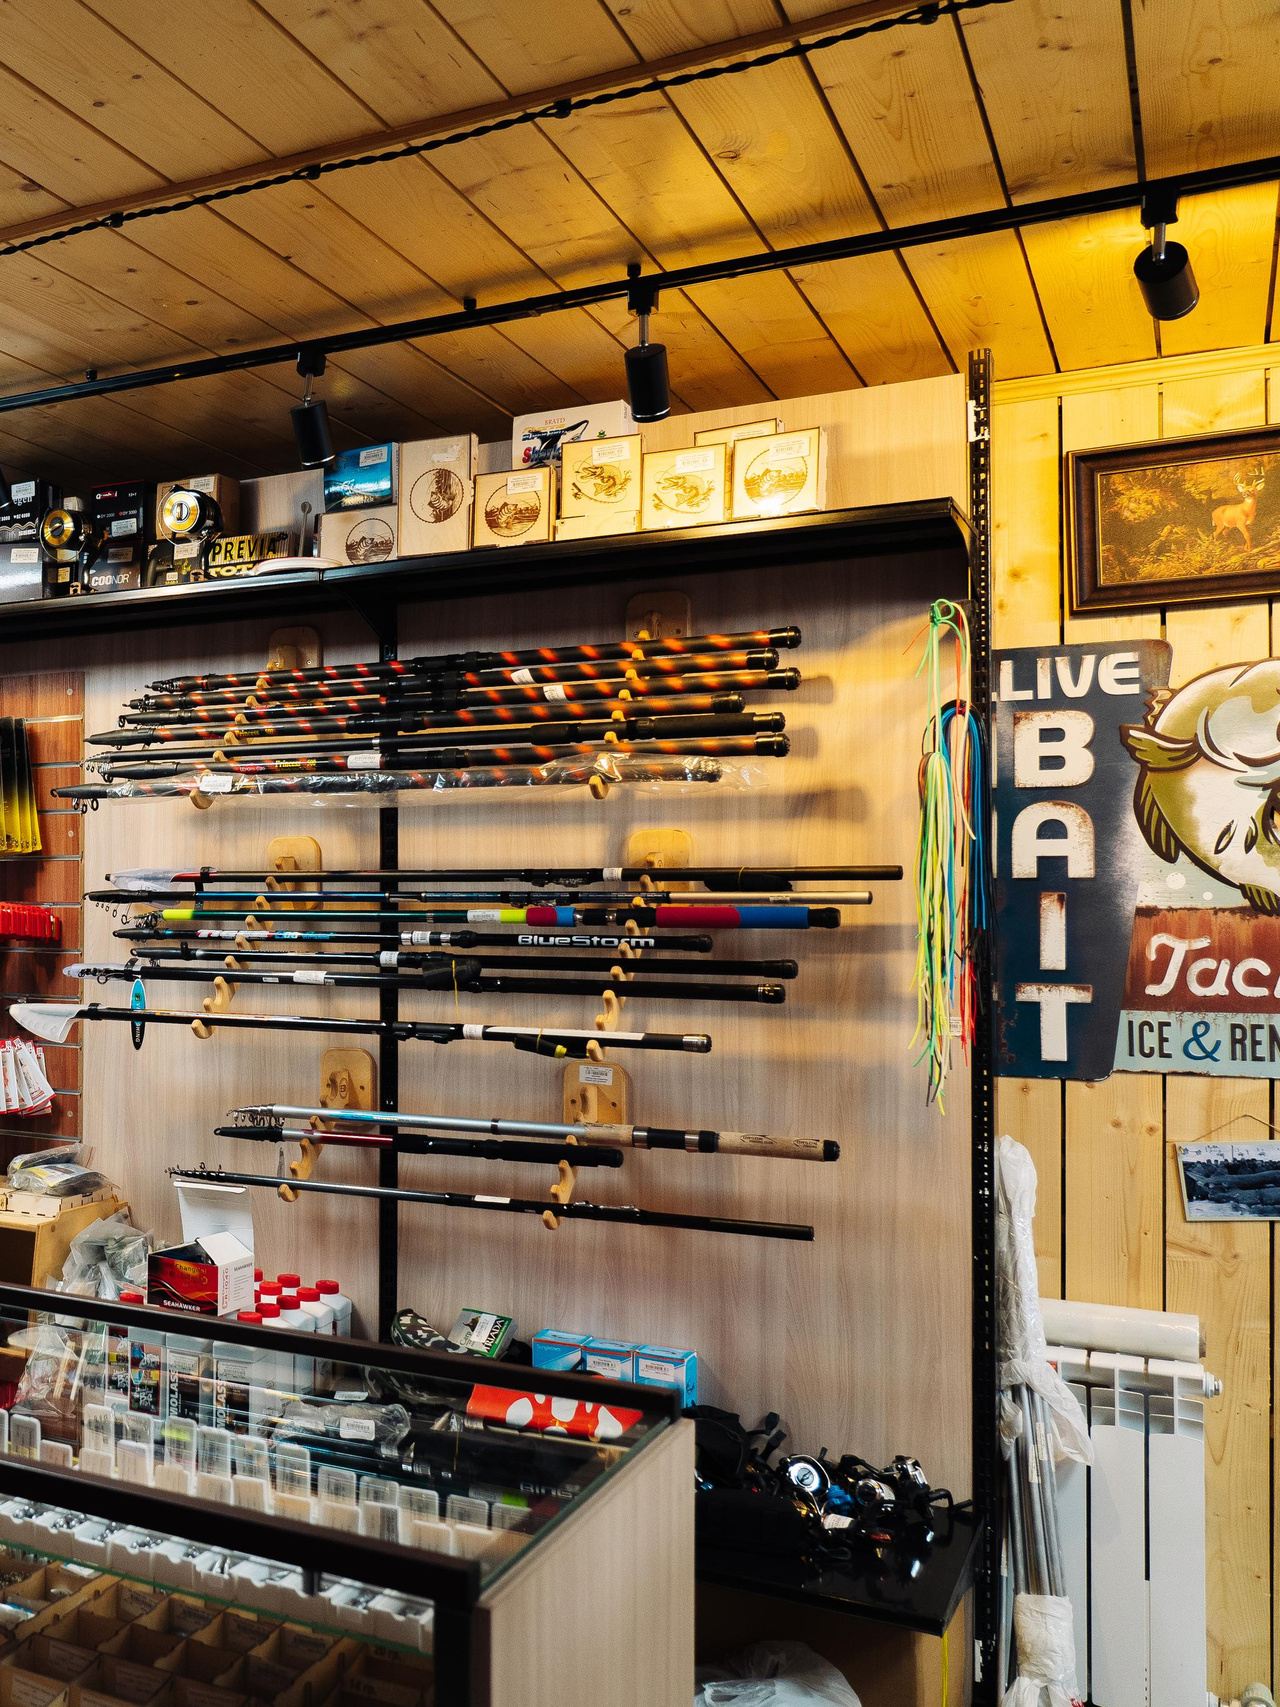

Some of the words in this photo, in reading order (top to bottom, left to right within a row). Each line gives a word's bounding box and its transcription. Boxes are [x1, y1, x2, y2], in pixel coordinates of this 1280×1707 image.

[210, 537, 277, 564] PREVIA
[91, 573, 130, 587] COONOR
[999, 651, 1140, 702] LIVE
[275, 759, 302, 768] Princess
[1010, 710, 1098, 1063] BAIT
[1144, 933, 1280, 999] Tac
[1127, 1020, 1173, 1059] ICE
[1182, 1020, 1222, 1062] &
[163, 1299, 201, 1311] SEAHAWKER
